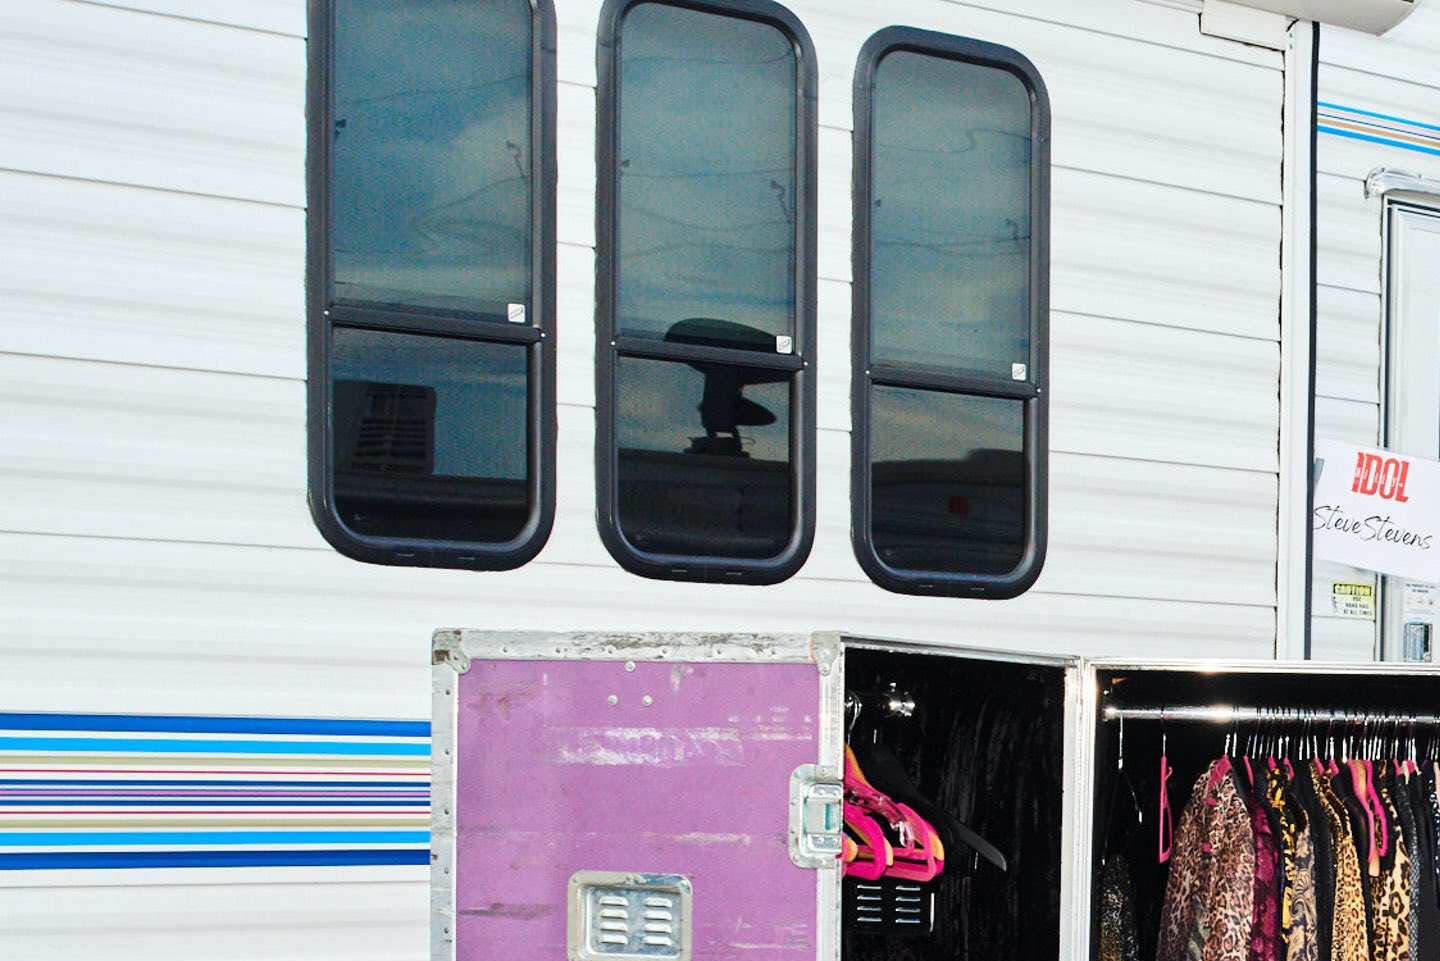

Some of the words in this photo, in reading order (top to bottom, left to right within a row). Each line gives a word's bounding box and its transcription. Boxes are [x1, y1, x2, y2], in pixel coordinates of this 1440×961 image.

[1352, 452, 1409, 502] IDOL
[1313, 505, 1361, 534] Steve
[1360, 515, 1433, 550] Stevens
